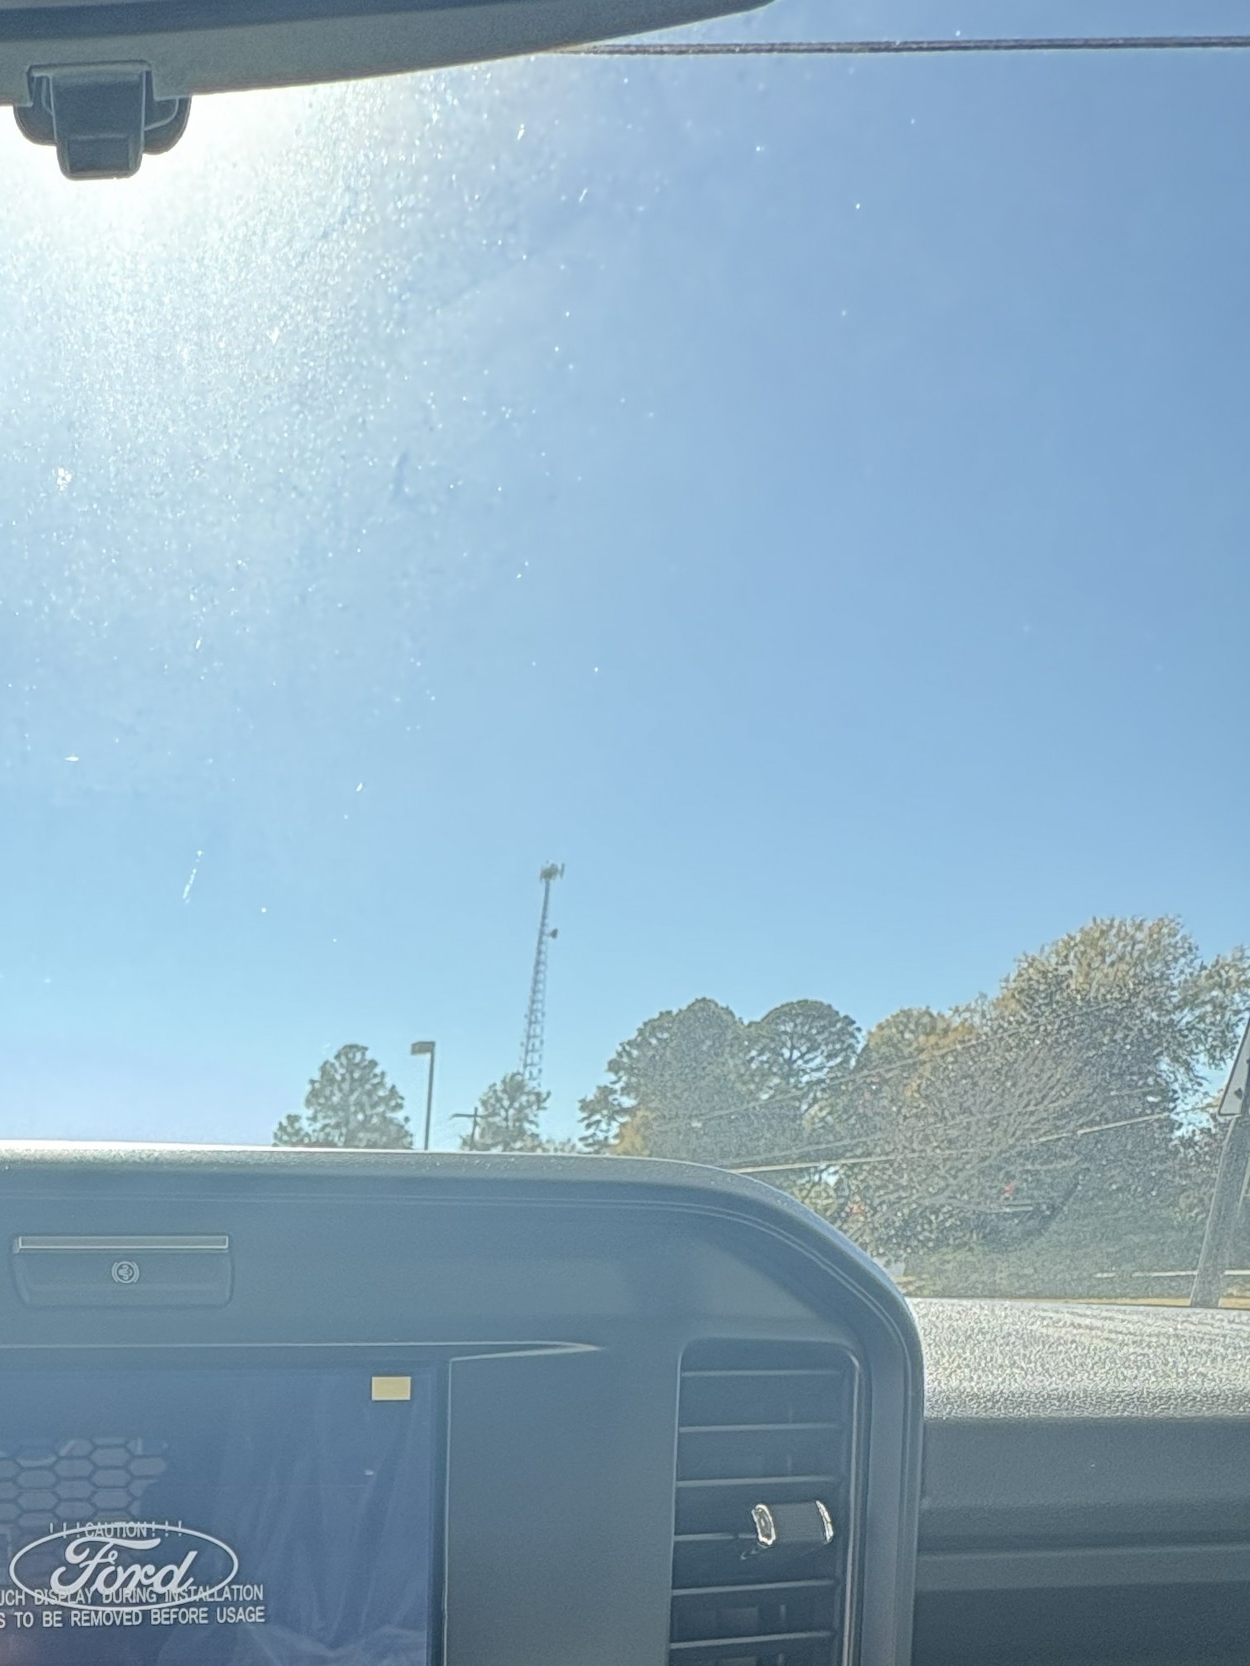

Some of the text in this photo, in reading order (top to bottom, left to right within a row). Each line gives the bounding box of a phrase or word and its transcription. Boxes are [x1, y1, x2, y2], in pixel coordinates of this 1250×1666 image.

[50, 1537, 198, 1595] Ford
[34, 1587, 93, 1606] DISPLAY
[102, 1586, 157, 1604] DURING
[165, 1584, 264, 1602] INSTALLATION
[13, 1611, 34, 1629] TO
[42, 1610, 63, 1628] BE
[71, 1609, 143, 1628] REMOVED
[150, 1607, 209, 1626] BEFORE
[216, 1605, 266, 1624] USAGE
